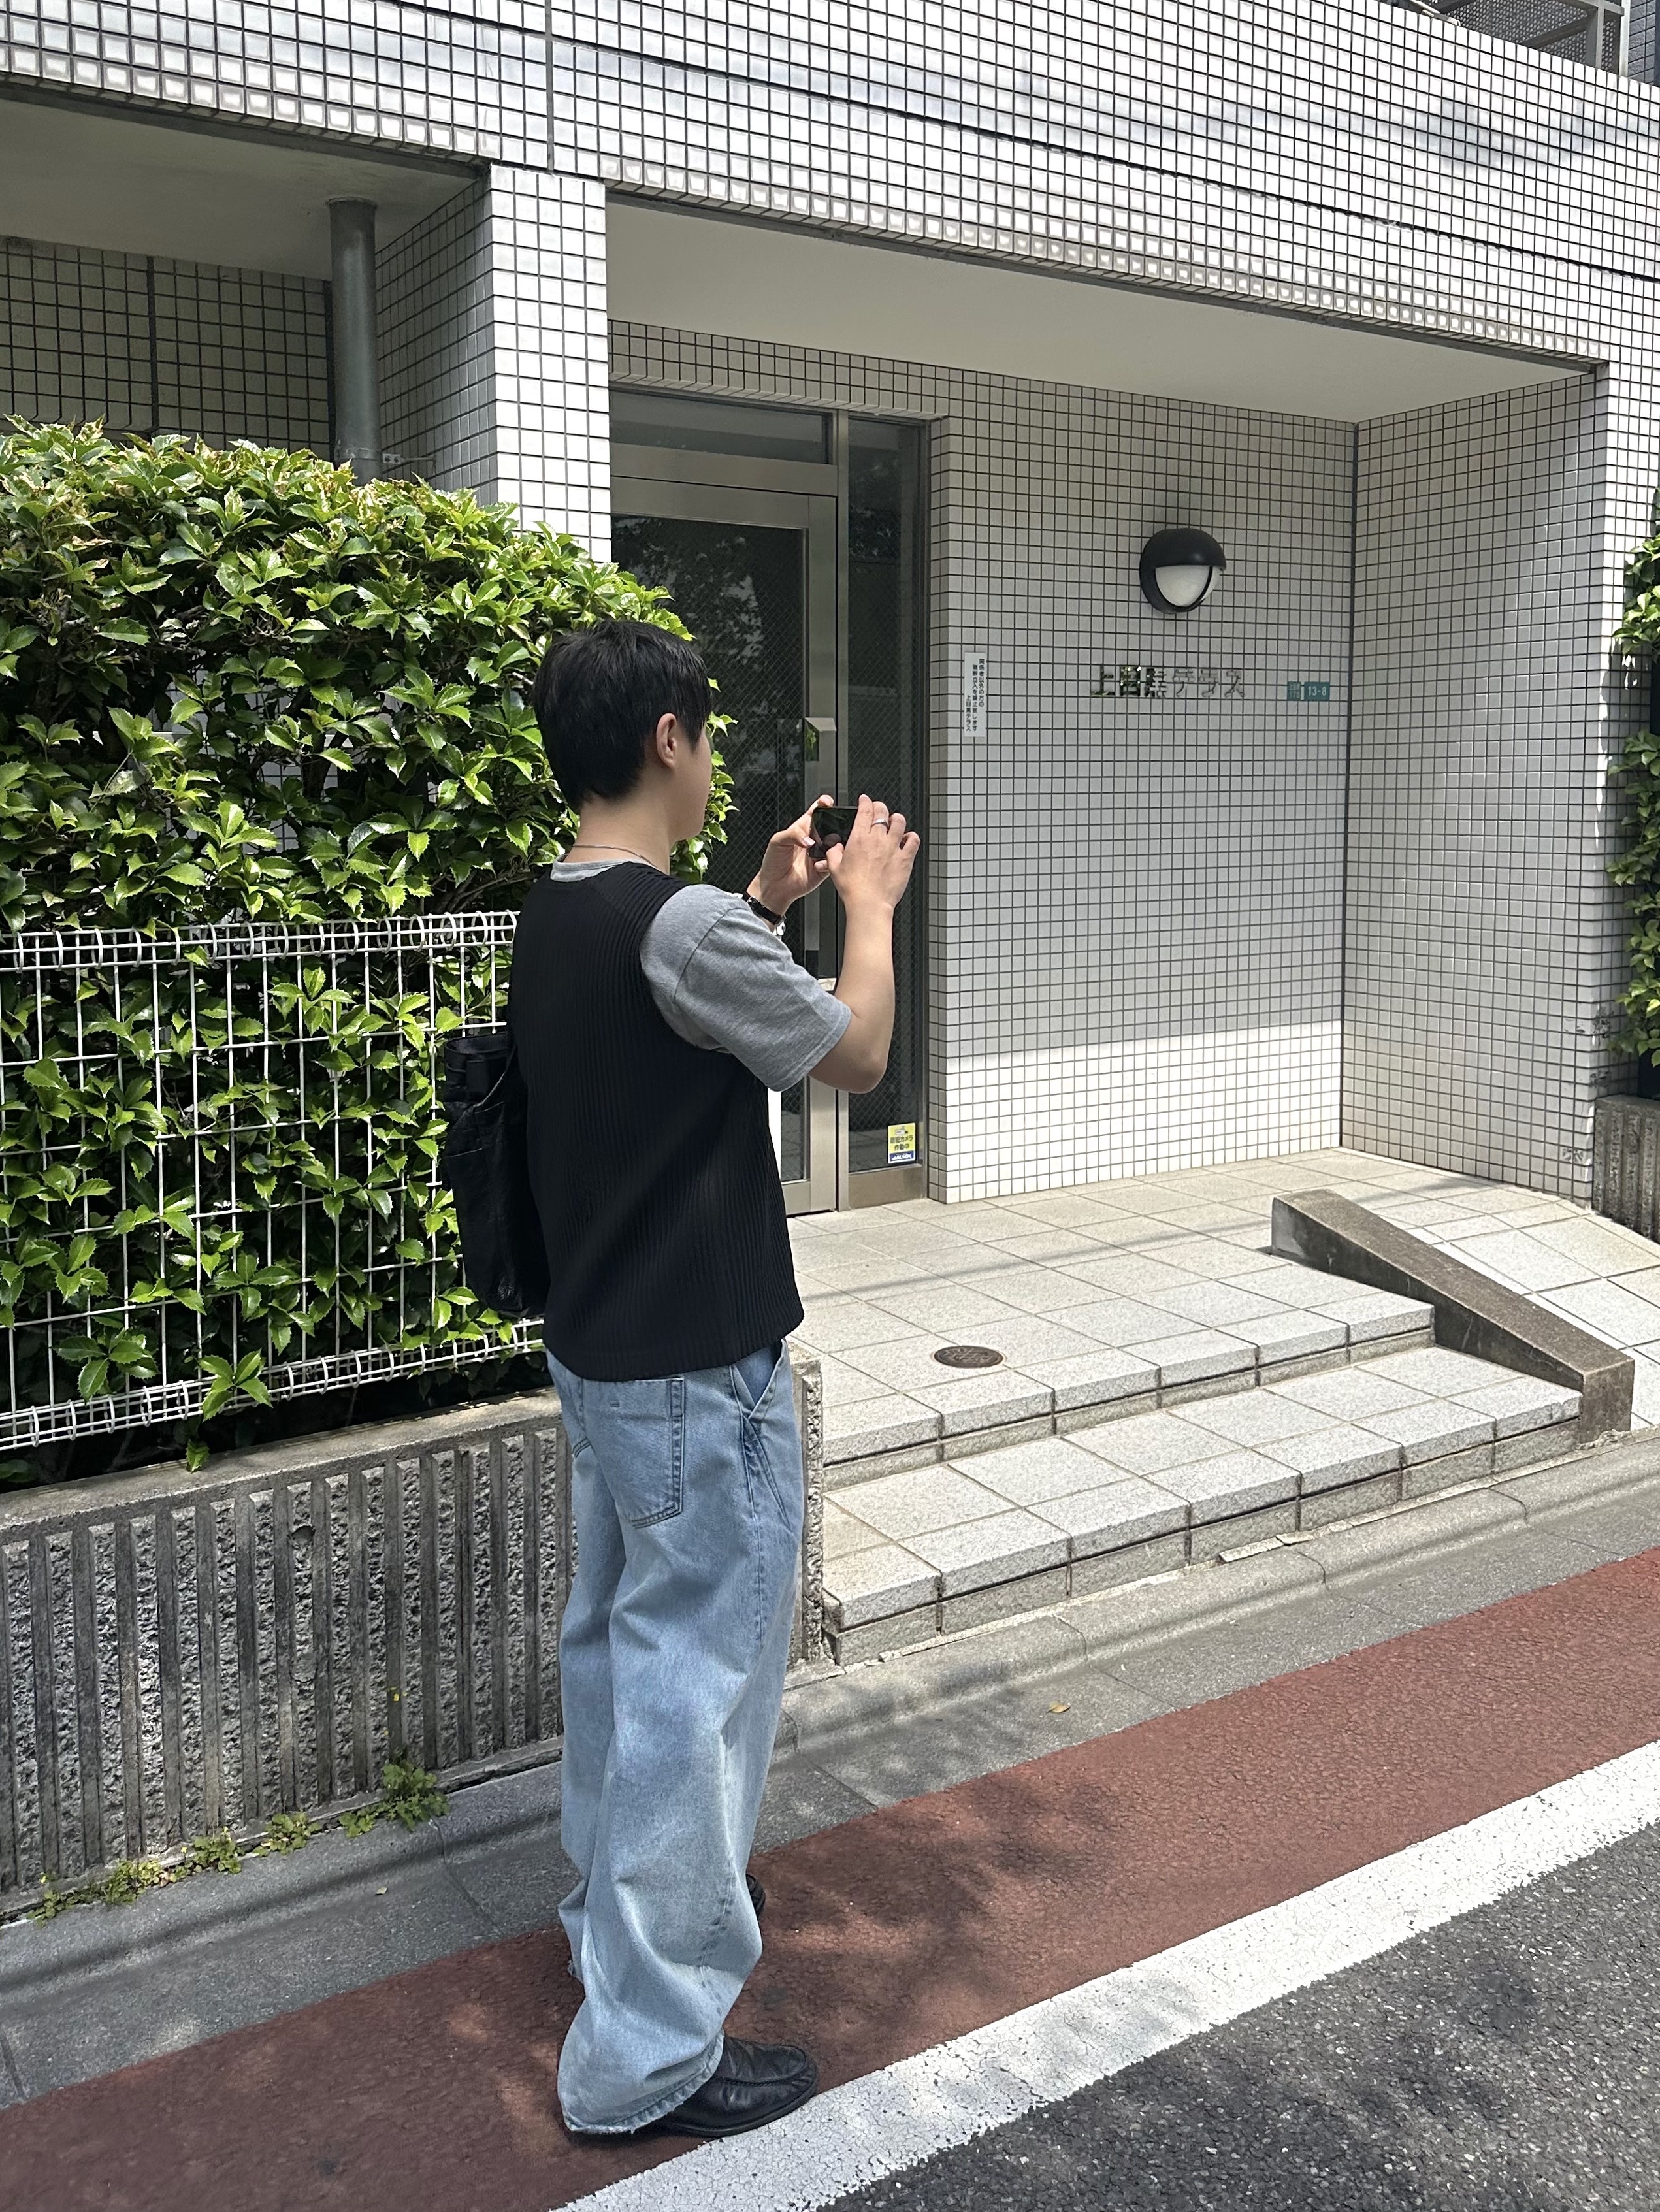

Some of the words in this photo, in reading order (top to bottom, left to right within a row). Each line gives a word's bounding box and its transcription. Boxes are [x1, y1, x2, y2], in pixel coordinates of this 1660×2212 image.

[1090, 665, 1245, 698] 上目黒テラス
[1309, 686, 1327, 696] 13-8
[890, 1135, 913, 1144] 防犯カメラ
